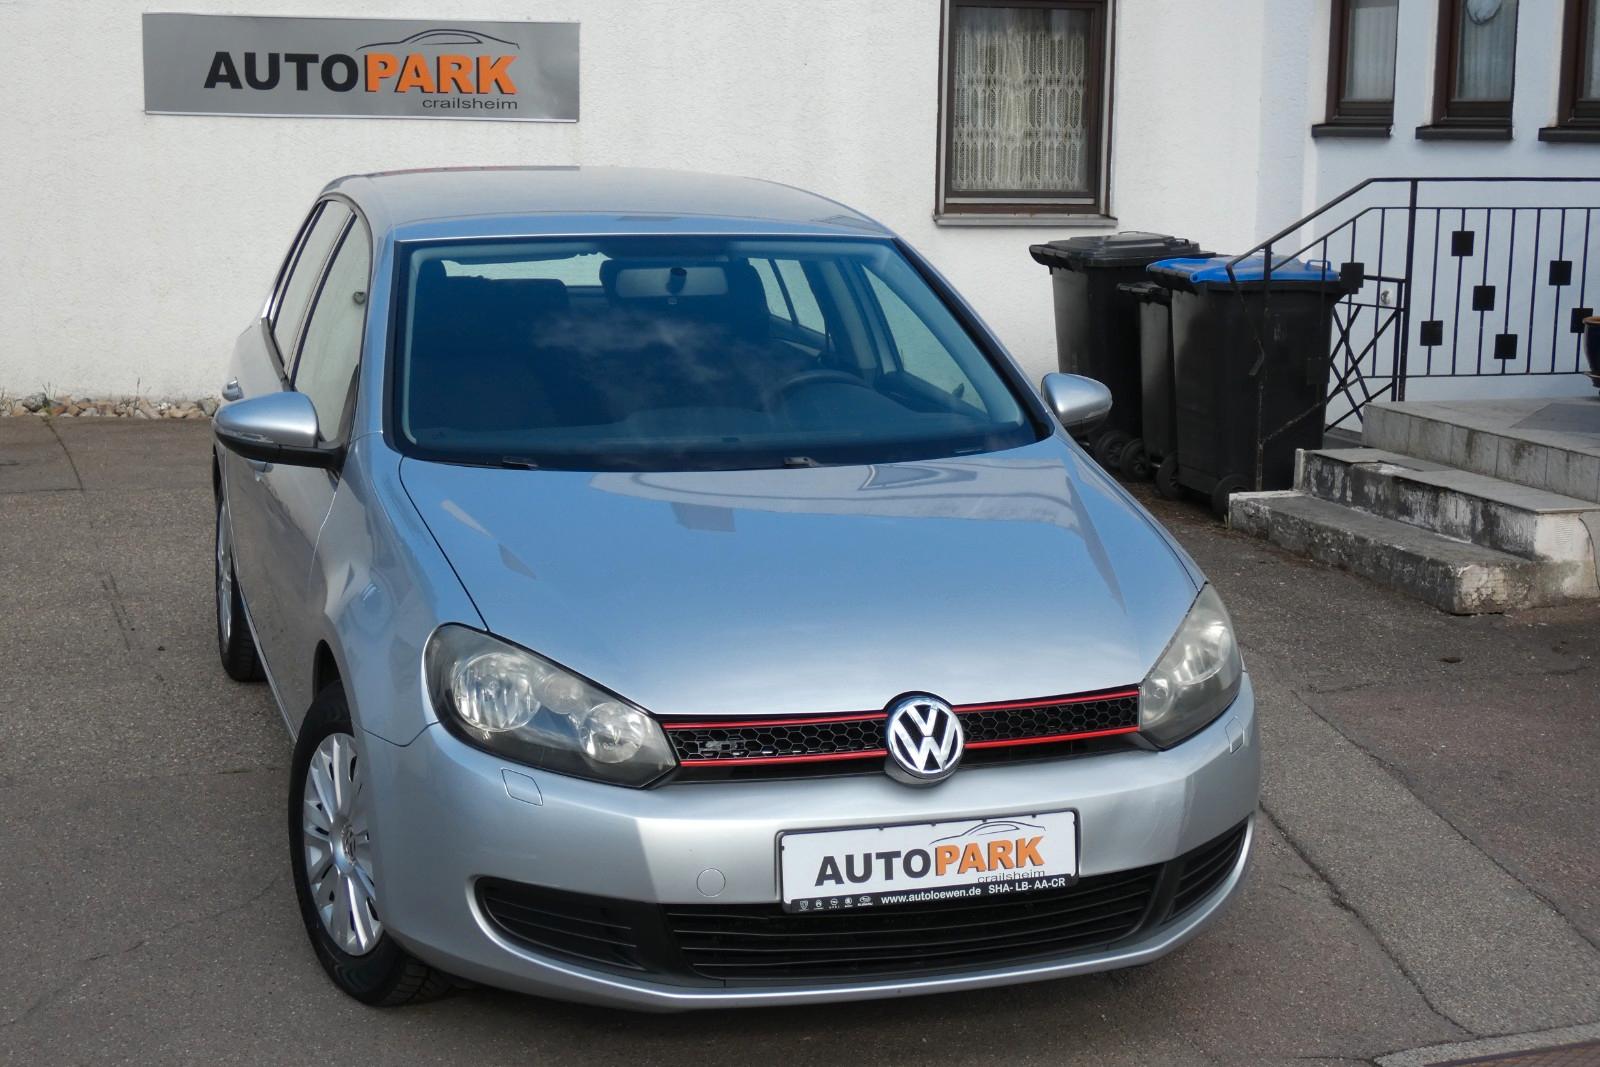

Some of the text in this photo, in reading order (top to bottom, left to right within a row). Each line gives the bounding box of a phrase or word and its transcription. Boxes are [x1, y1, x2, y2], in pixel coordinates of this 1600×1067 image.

[203, 51, 519, 95] AUTOPARK
[422, 97, 518, 110] crailsheim
[814, 835, 1046, 886] AUTOPARK
[977, 869, 1045, 883] crailsheim
[880, 886, 982, 905] www.autoloewen.de
